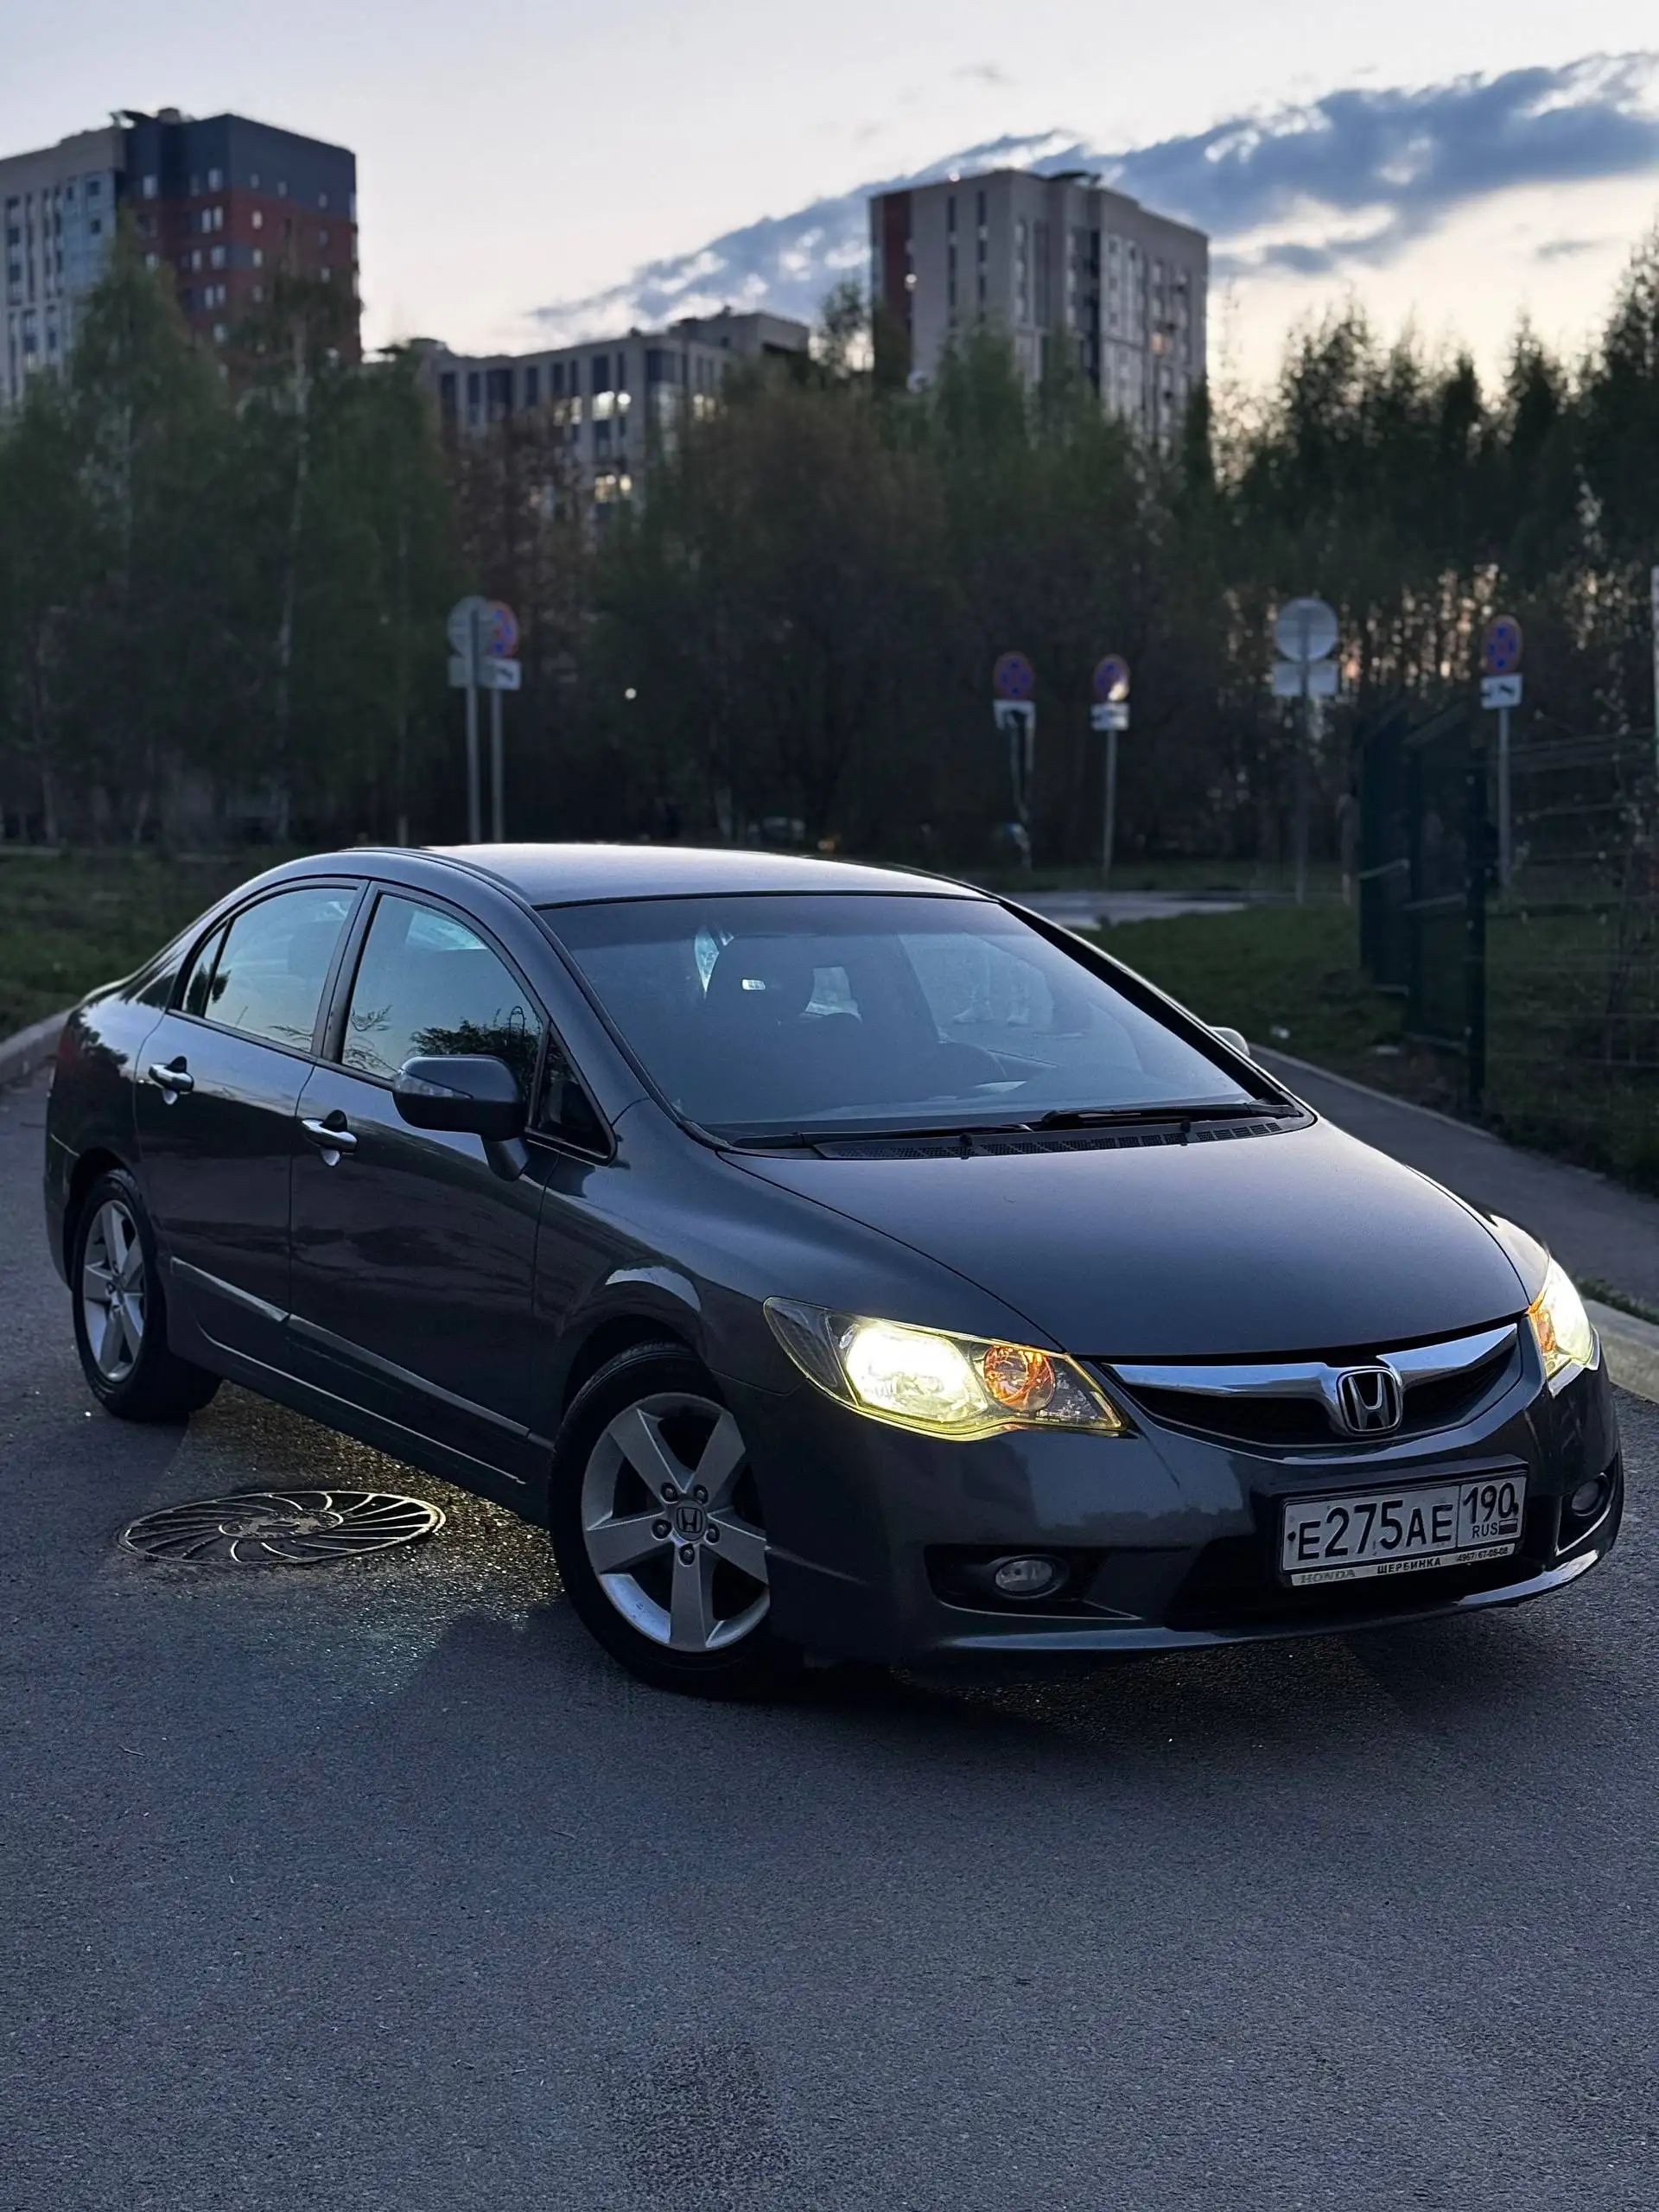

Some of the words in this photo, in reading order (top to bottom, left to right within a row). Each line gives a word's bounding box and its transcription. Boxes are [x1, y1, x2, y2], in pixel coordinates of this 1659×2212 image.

[1463, 1482, 1516, 1524] 190
[1471, 1522, 1498, 1538] RUS
[1300, 1569, 1356, 1584] HONDA
